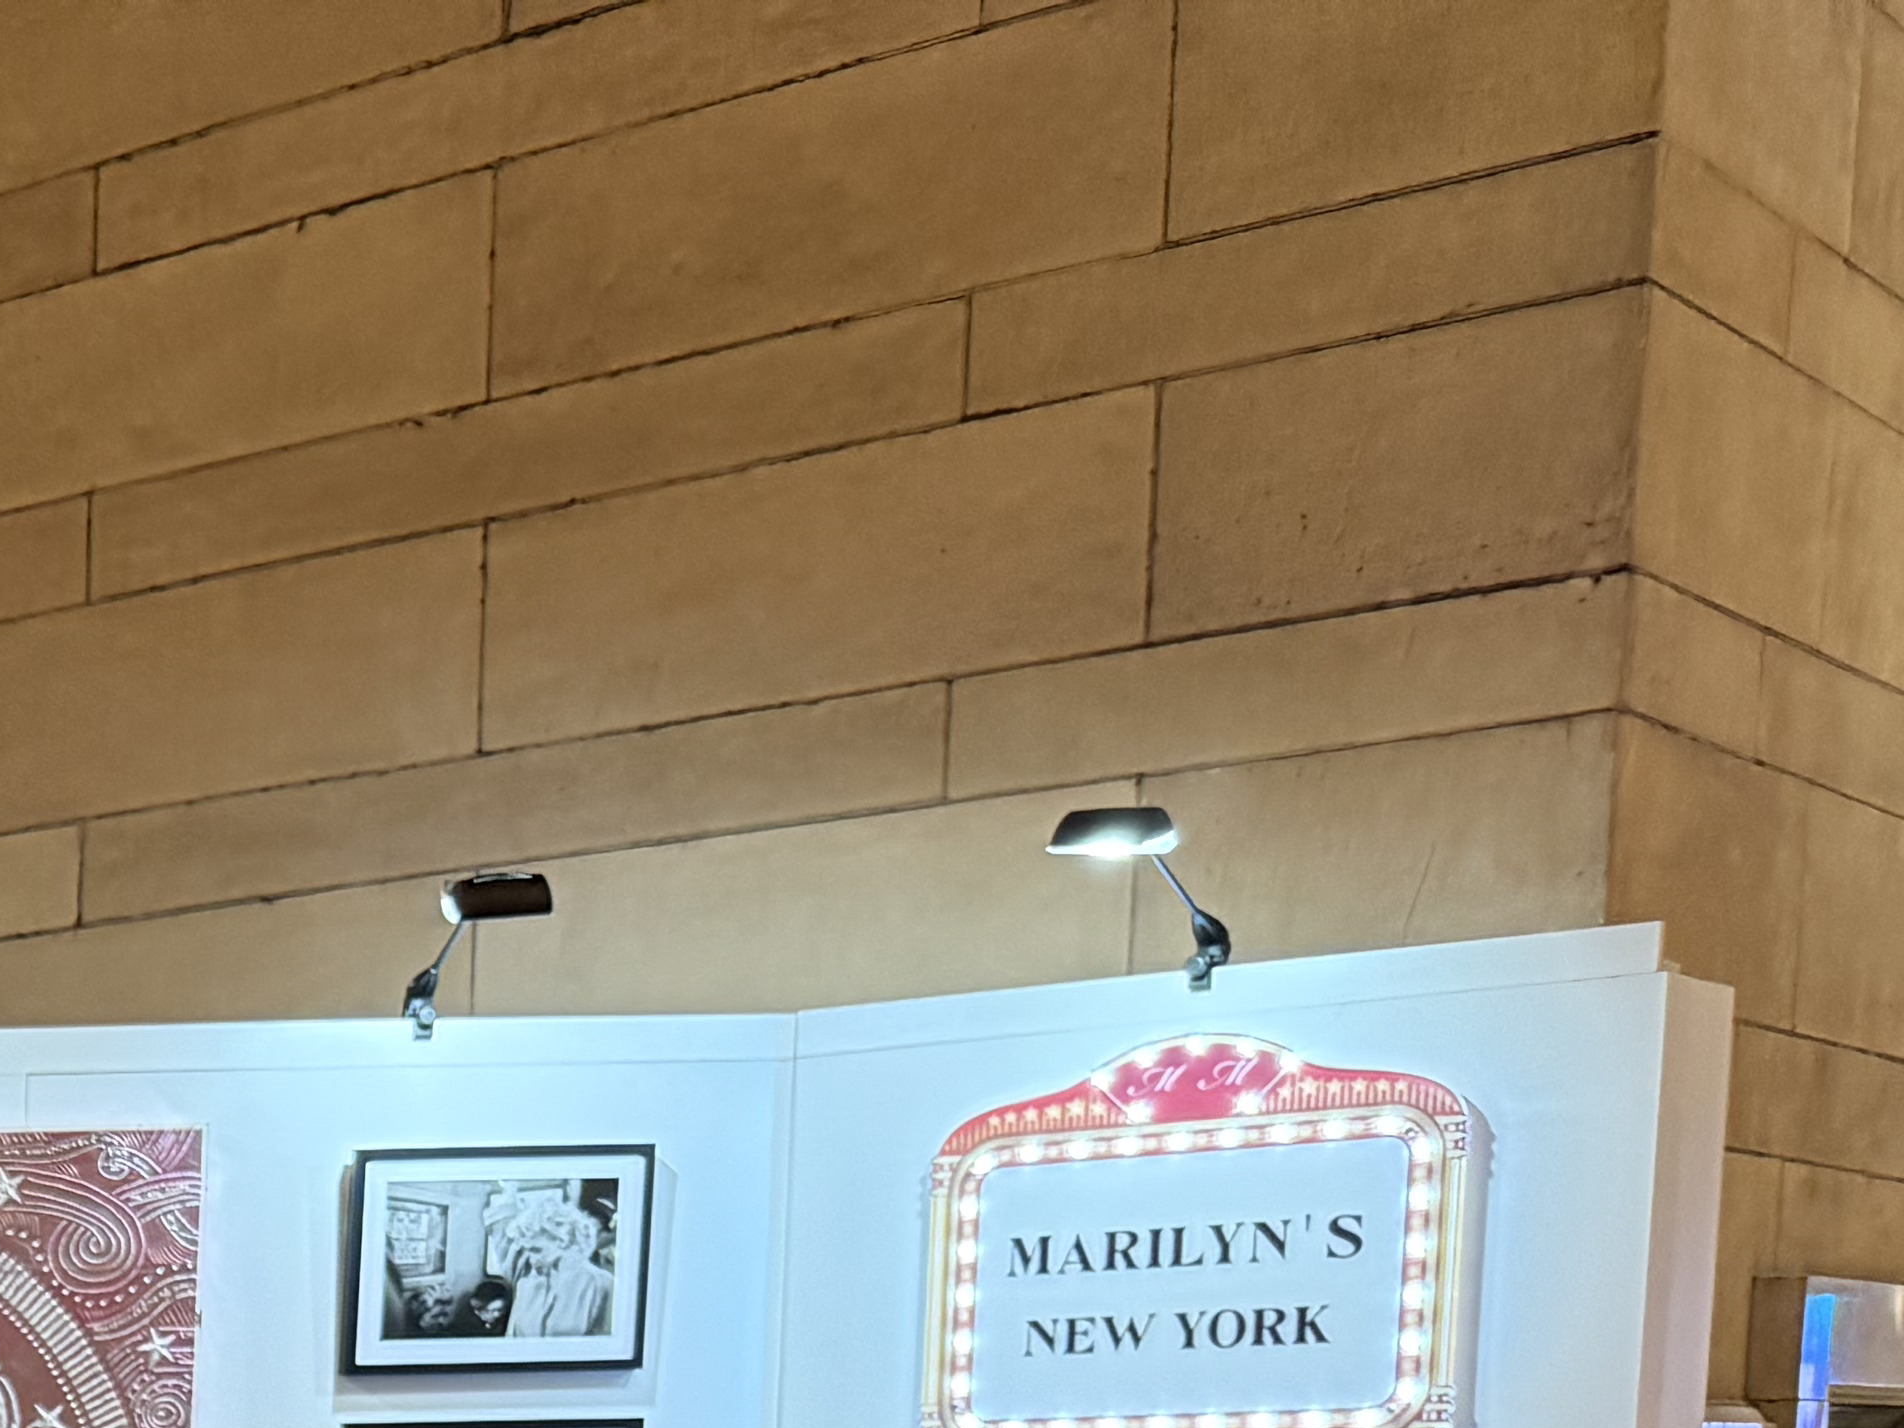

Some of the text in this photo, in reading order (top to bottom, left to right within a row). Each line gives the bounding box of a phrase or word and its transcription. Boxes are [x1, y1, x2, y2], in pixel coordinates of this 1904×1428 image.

[1007, 1213, 1364, 1278] MARILYN'S
[1023, 1303, 1331, 1357] NEW YORK
